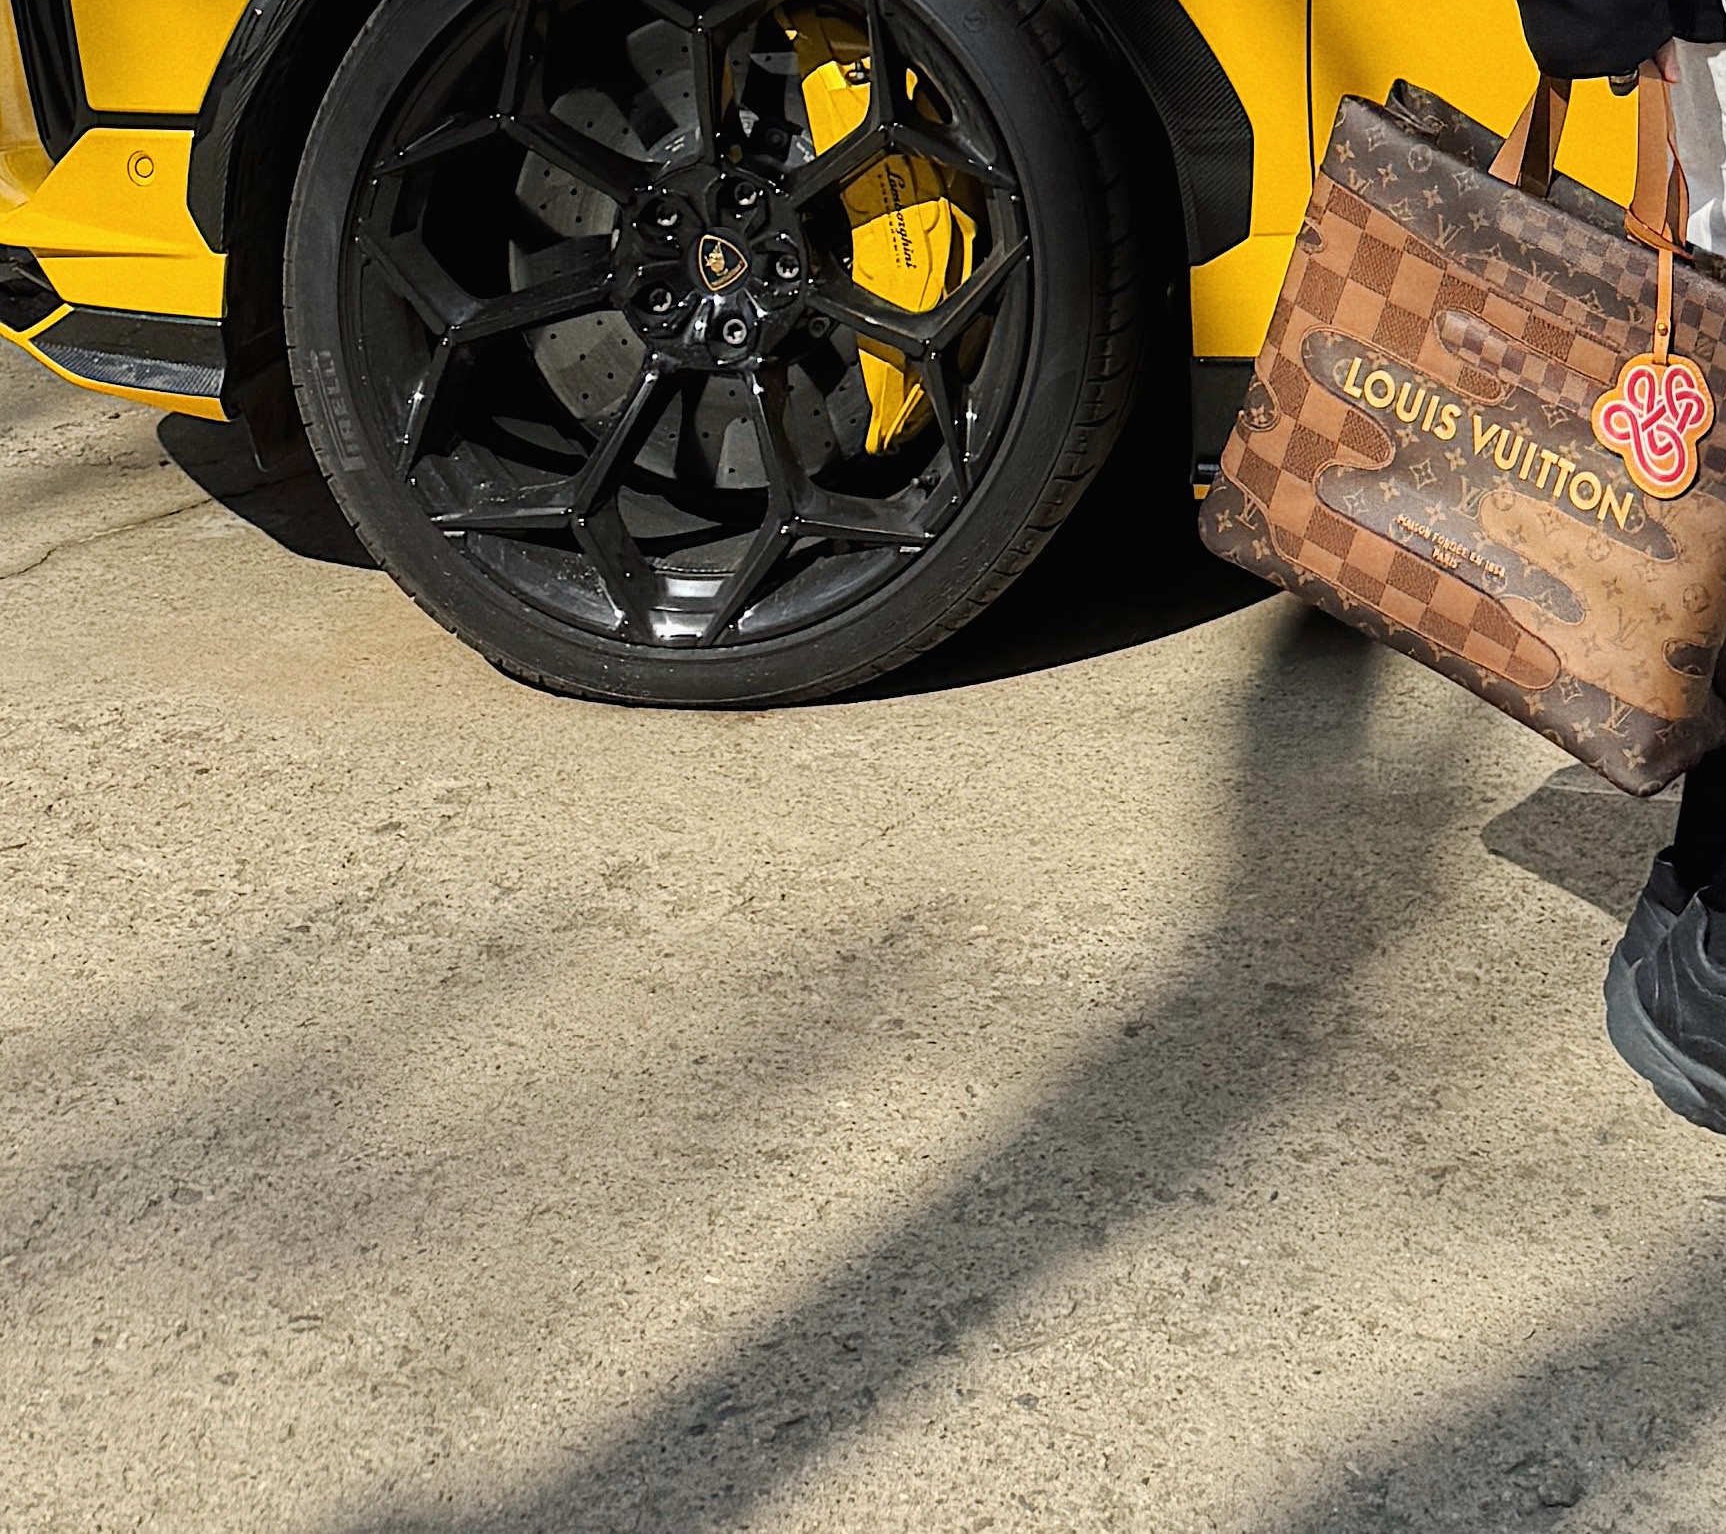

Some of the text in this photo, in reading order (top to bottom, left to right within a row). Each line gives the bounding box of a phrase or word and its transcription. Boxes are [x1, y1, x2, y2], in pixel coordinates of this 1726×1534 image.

[885, 162, 917, 269] Lamborghini
[1343, 356, 1635, 531] LOUIS VUITTON
[1432, 545, 1459, 569] PARIS
